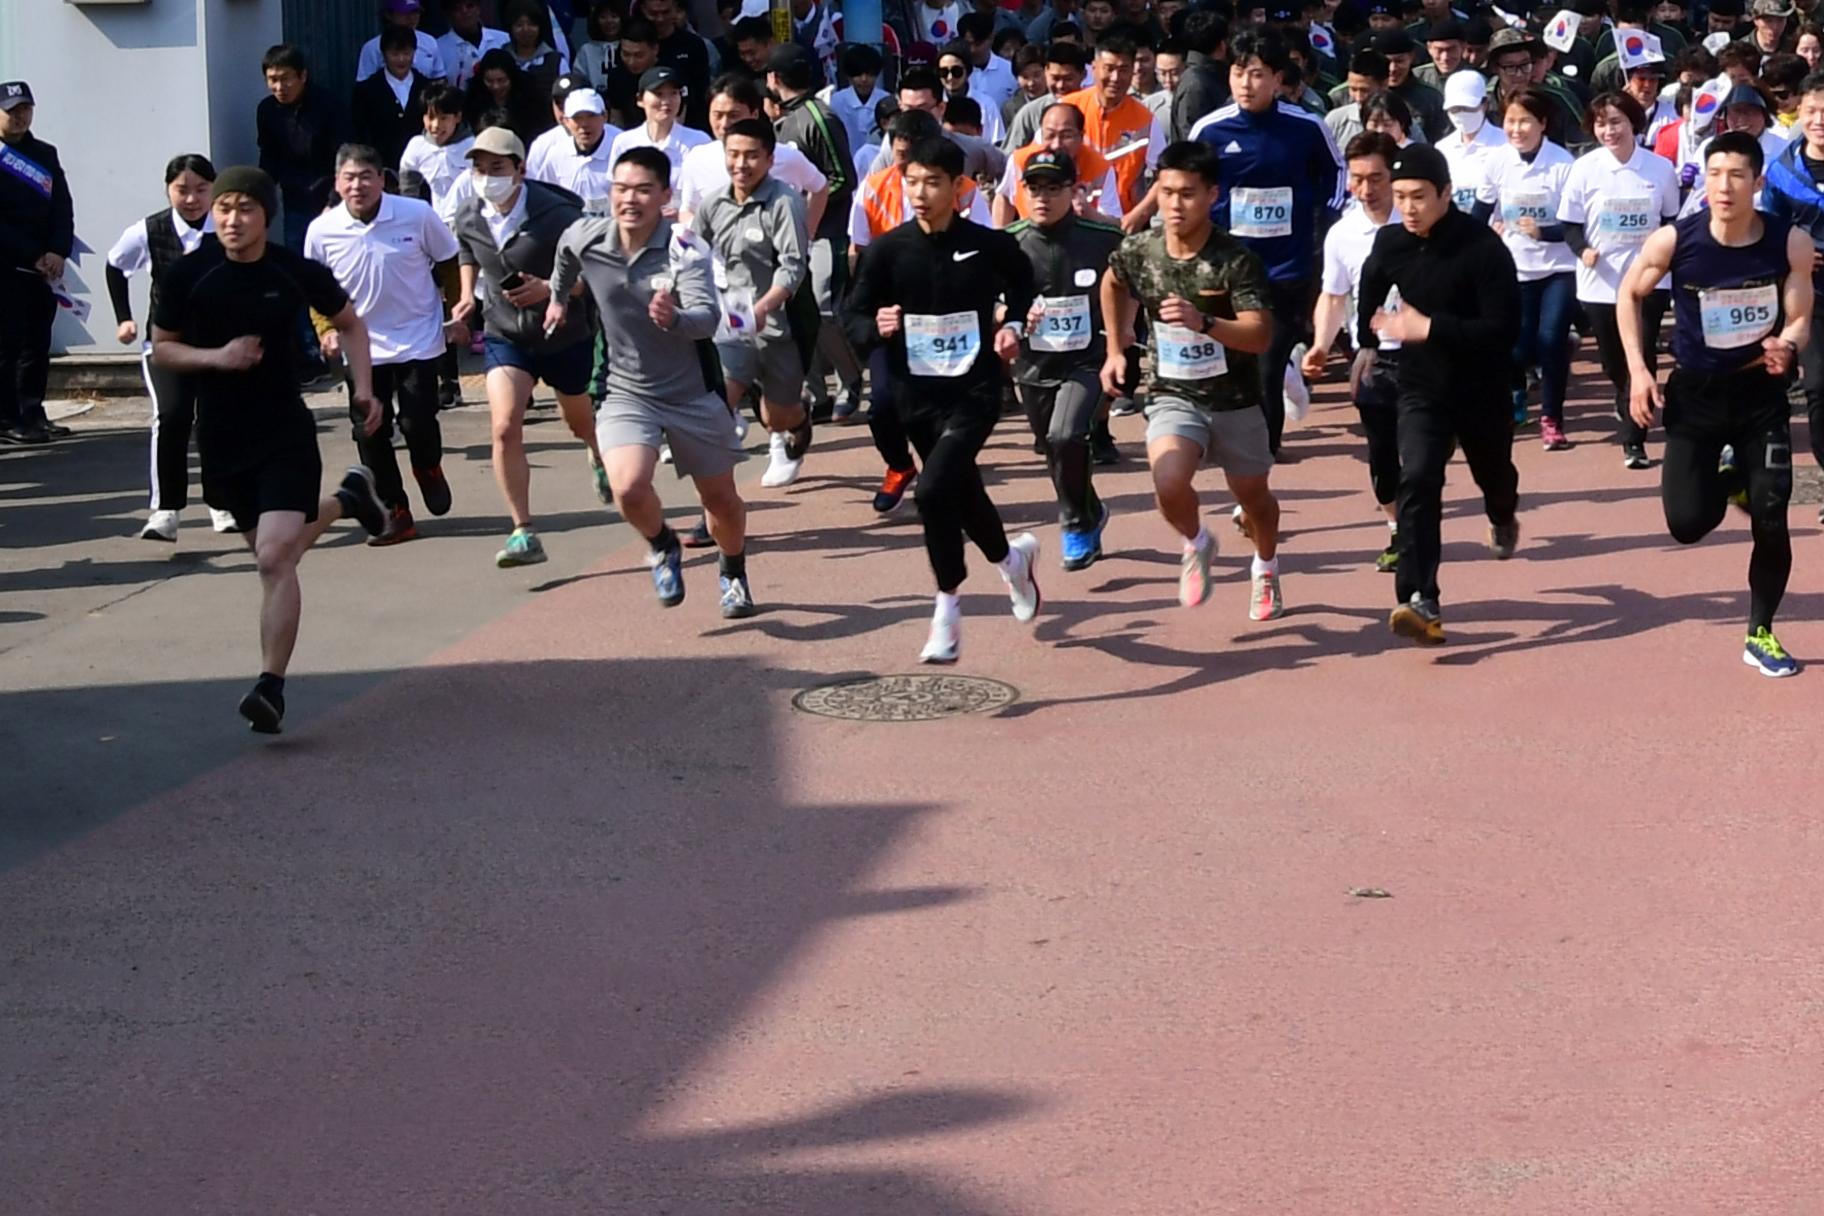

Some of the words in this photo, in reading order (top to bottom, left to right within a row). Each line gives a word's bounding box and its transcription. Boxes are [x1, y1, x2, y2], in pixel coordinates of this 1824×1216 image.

[1254, 206, 1286, 220] 870
[1619, 214, 1648, 227] 256
[1049, 315, 1083, 332] 337
[1730, 305, 1770, 325] 965
[932, 335, 968, 354] 941
[1180, 342, 1216, 360] 438
